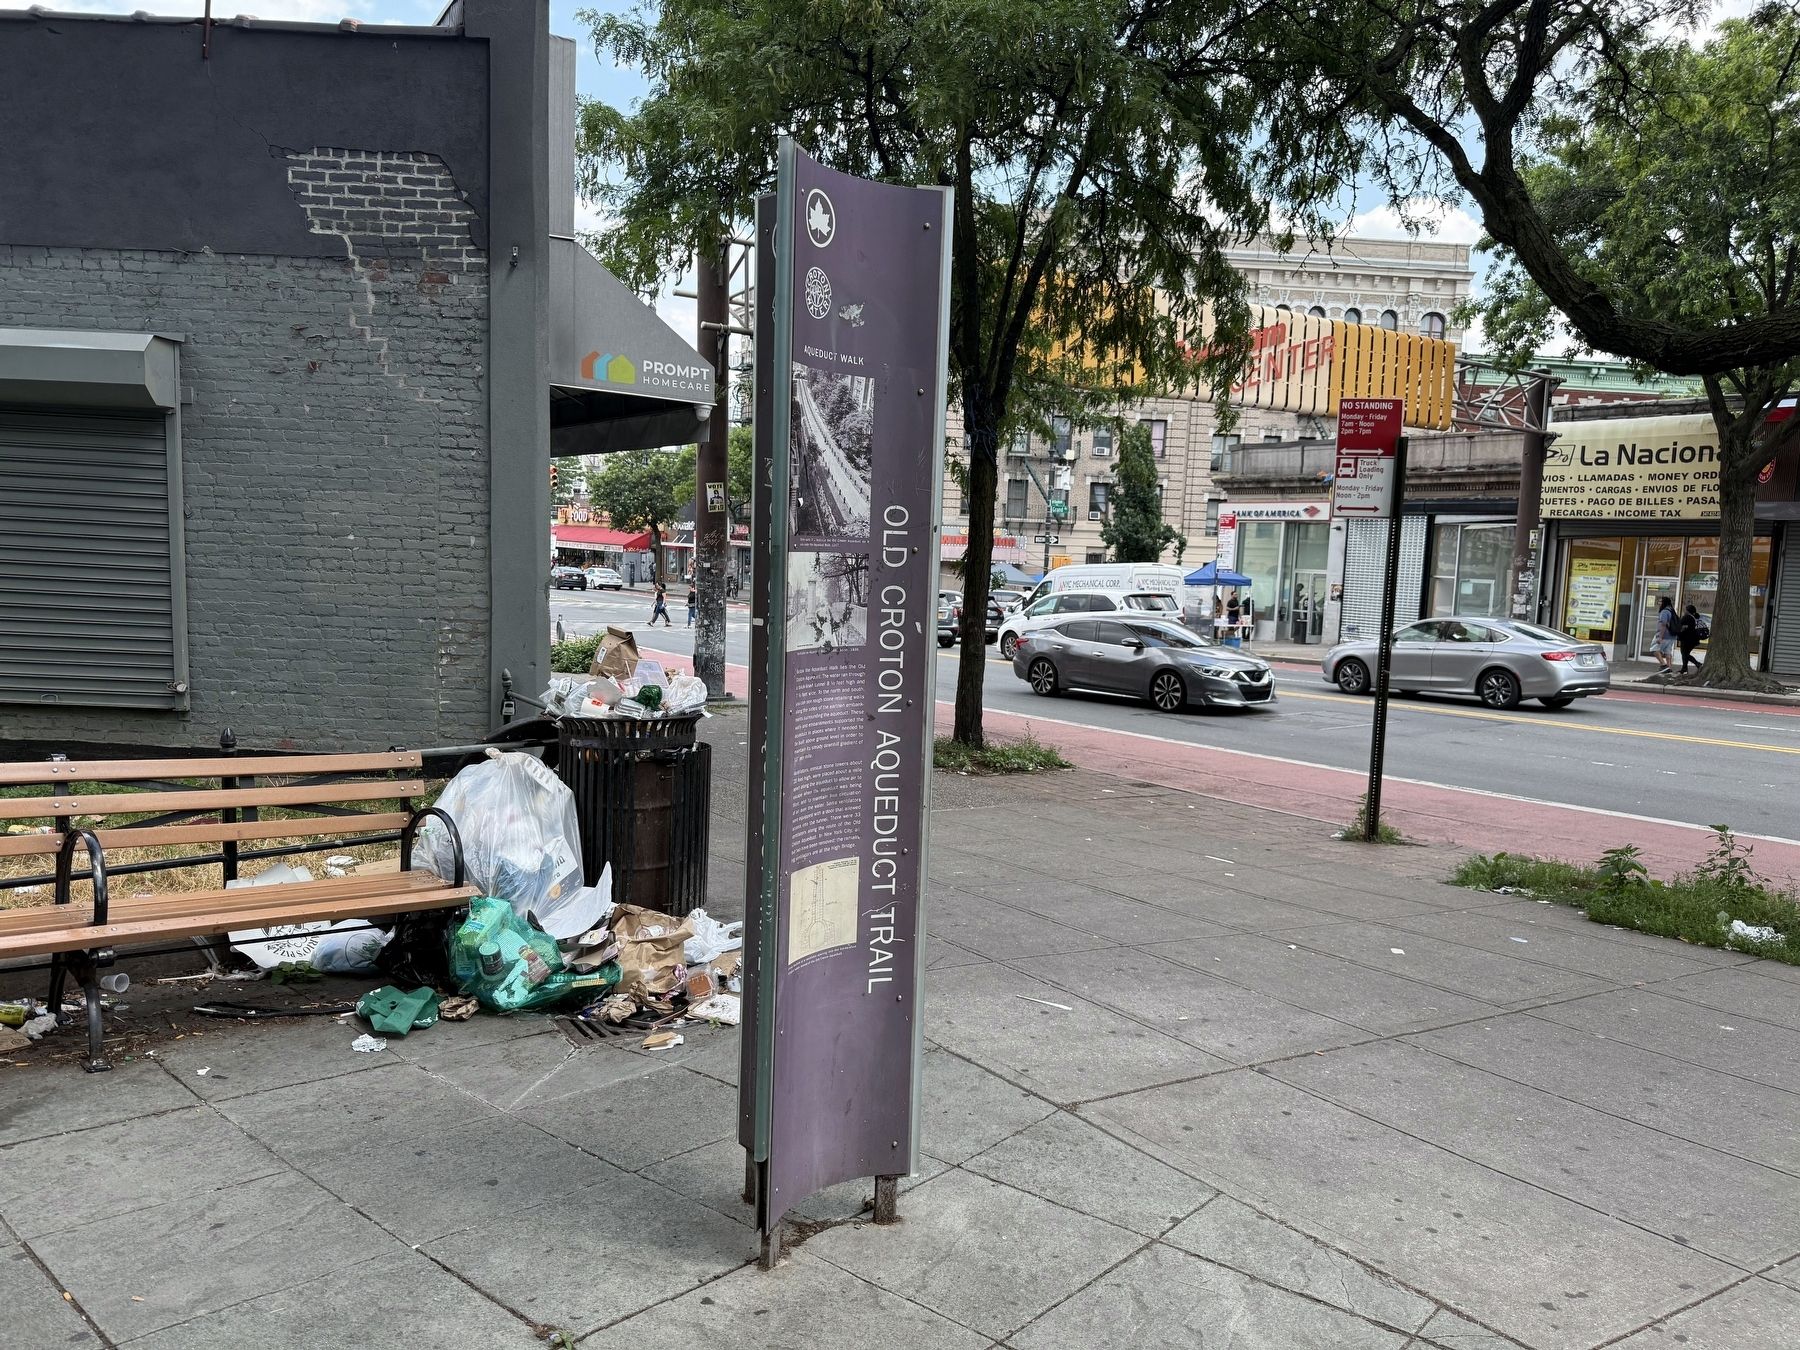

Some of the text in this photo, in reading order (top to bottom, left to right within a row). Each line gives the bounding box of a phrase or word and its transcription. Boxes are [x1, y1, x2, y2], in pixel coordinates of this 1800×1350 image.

[804, 345, 864, 365] AQUEDUCT WALK
[643, 360, 710, 380] PROMPT
[643, 376, 710, 392] HOMECARE
[1342, 402, 1393, 410] NO STANDING
[1580, 446, 1608, 466] La
[1578, 474, 1634, 482] LLAMADAS
[1694, 472, 1721, 480] ORD
[1642, 485, 1678, 493] ENVIOS
[1072, 580, 1104, 588] MECHANICAL
[868, 505, 908, 994] OLD CROTON AQUEDUCT TRAIL
